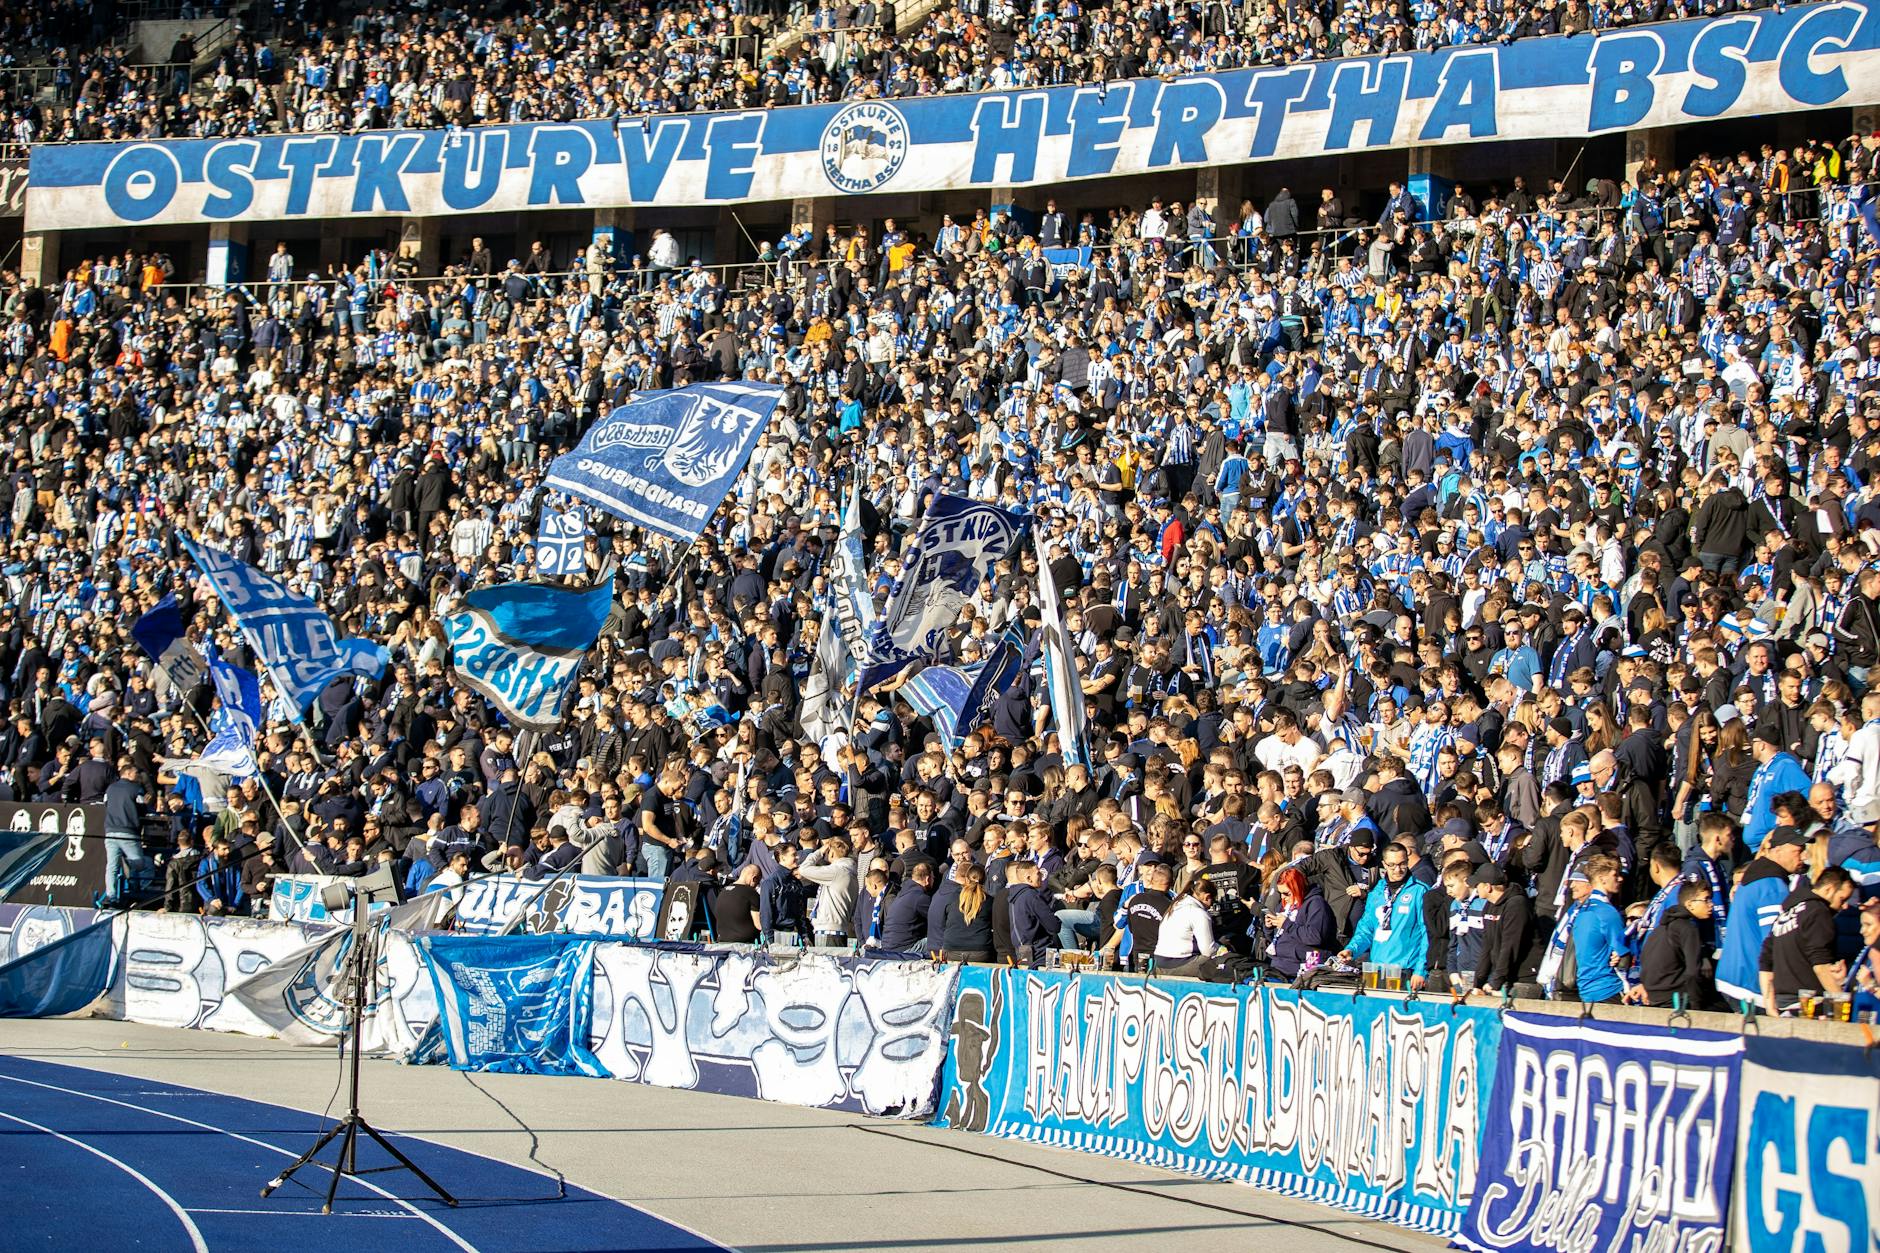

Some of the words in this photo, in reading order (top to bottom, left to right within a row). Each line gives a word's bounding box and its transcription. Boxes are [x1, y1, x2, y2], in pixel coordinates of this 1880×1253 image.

[970, 48, 1500, 184] HERTHA
[1586, 2, 1867, 132] BSC
[831, 106, 901, 137] OSTKURVE
[827, 144, 838, 152] 18
[889, 140, 902, 149] 92
[102, 111, 767, 221] OSTKURVE
[826, 158, 872, 189] HERTHA
[875, 156, 900, 183] BSC
